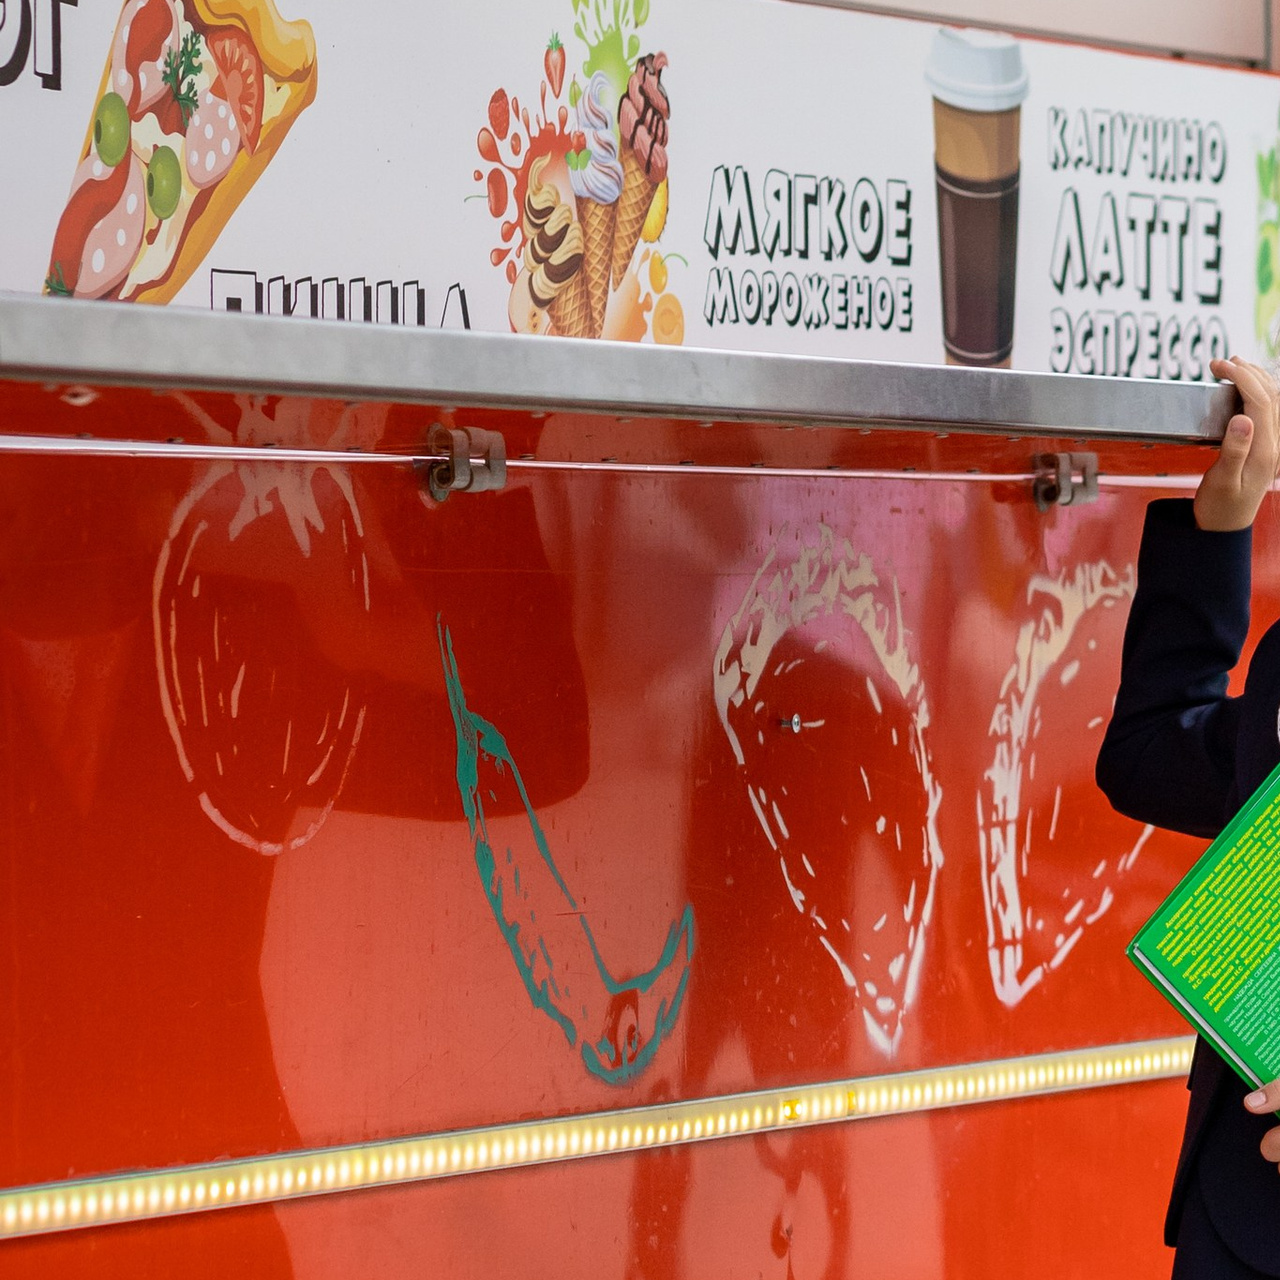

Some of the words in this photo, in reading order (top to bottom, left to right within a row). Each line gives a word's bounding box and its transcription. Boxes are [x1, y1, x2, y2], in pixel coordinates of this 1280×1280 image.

[1049, 107, 1227, 184] КАПУЧИНО
[704, 164, 912, 267] МЯГКОЕ
[1050, 186, 1223, 306] ЛАТТЕ
[703, 267, 913, 333] МОРОЖЕНОЕ
[1050, 306, 1230, 382] ЭСПРЕССО
